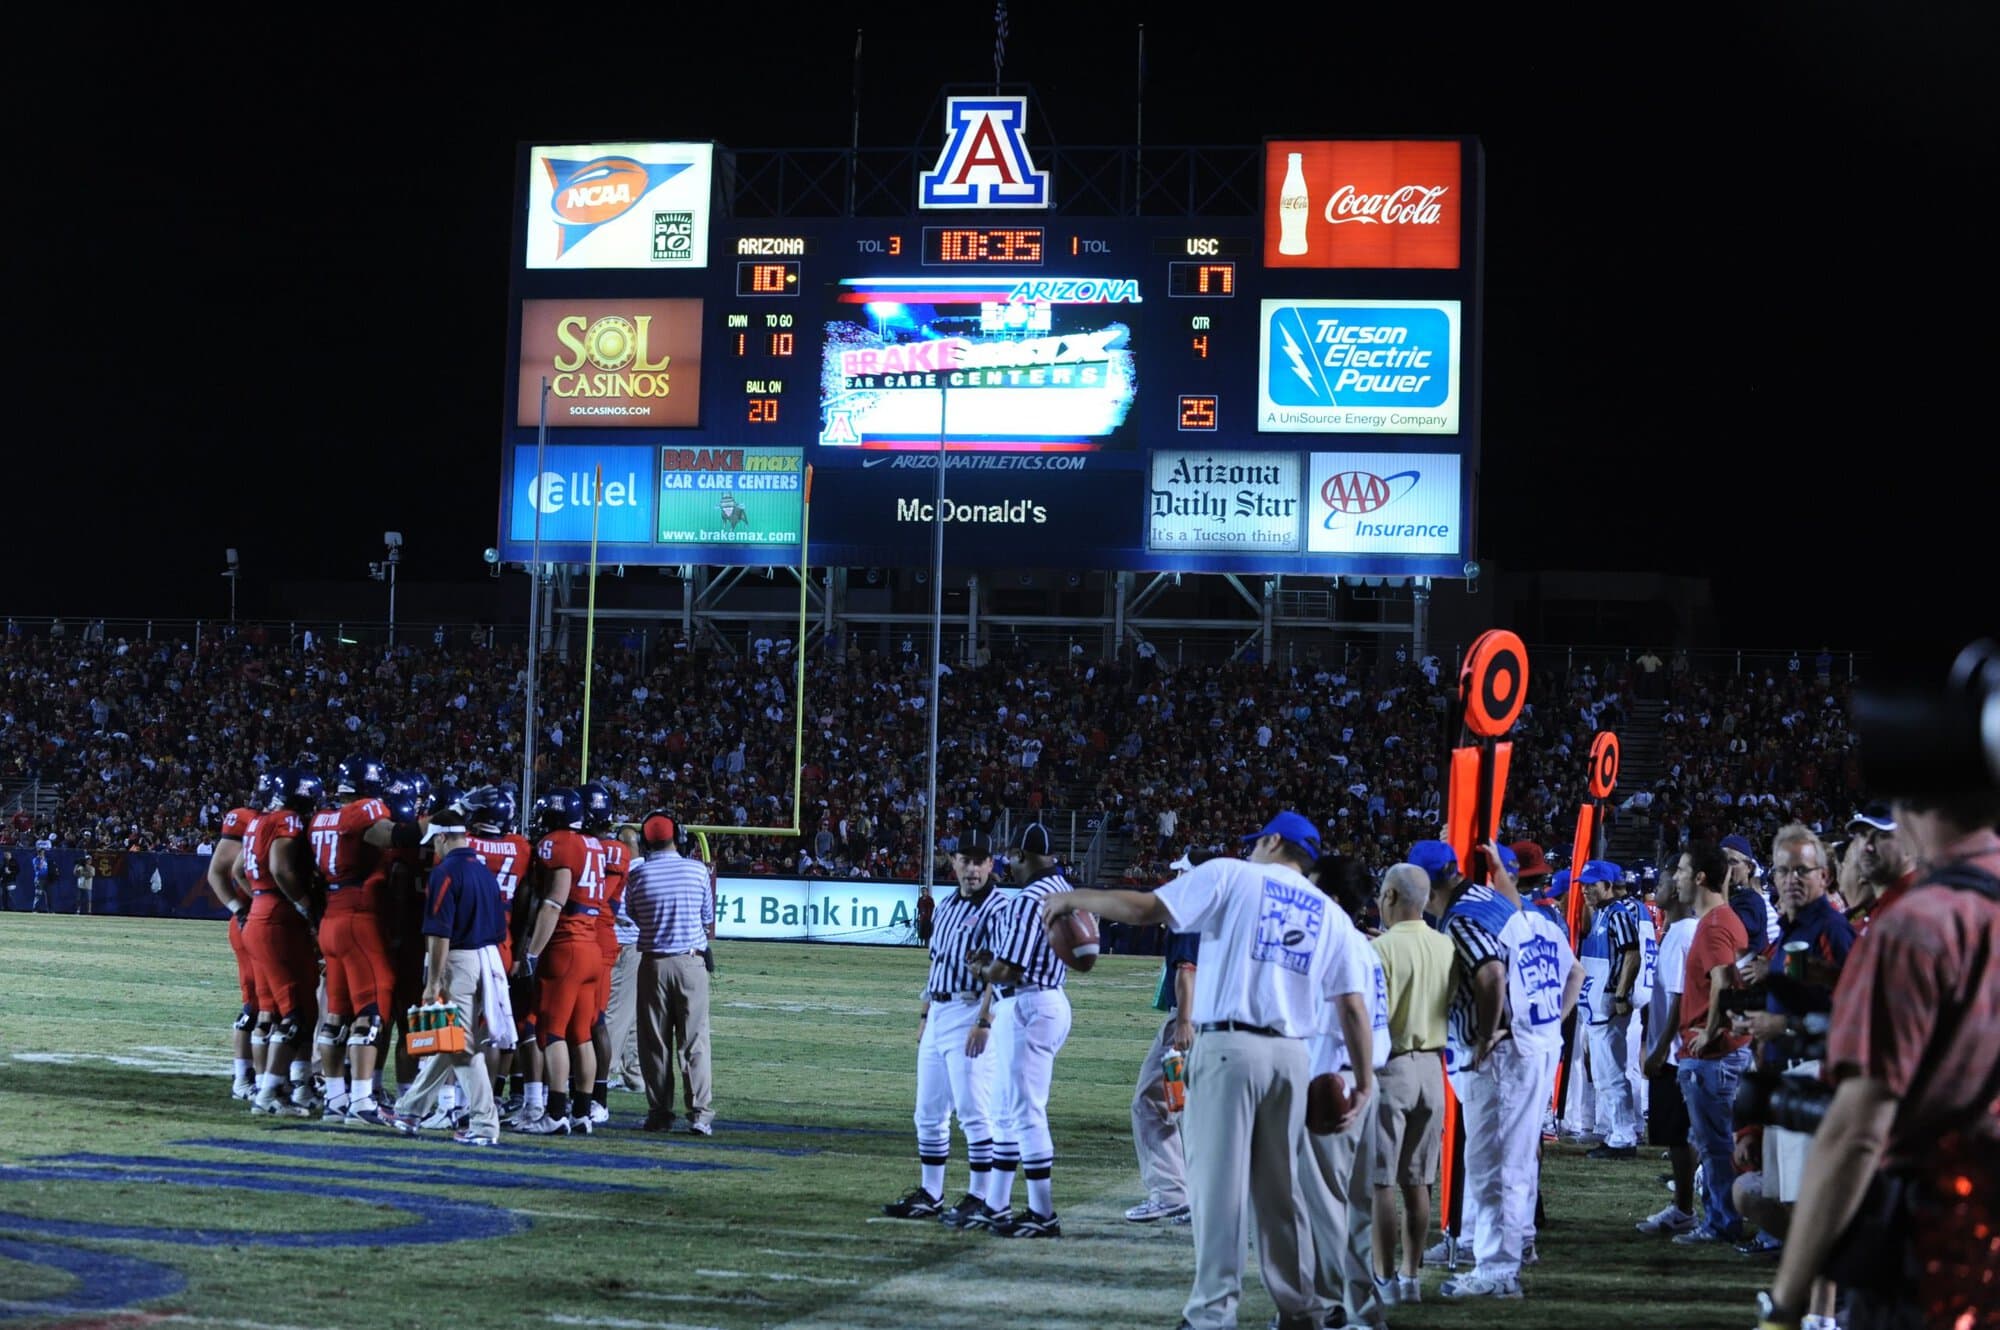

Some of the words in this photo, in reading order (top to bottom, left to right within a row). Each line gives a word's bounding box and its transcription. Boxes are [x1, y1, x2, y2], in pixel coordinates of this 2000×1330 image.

[919, 96, 1049, 208] A
[566, 183, 630, 208] NCAA
[1325, 185, 1448, 225] Coca-Cola
[655, 223, 691, 235] PAC
[655, 235, 691, 251] 10
[738, 237, 804, 255] ARIZONA
[856, 240, 885, 252] TOL
[889, 236, 900, 255] 3
[941, 231, 1041, 261] 10:35
[1082, 240, 1111, 252] TOL
[1186, 238, 1219, 255] USC
[753, 266, 785, 291] 10
[1199, 266, 1232, 292] 17
[1008, 279, 1141, 302] ARIZONA
[728, 315, 748, 327] DWN
[766, 315, 777, 327] TO
[779, 315, 792, 327] GO
[1192, 316, 1210, 330] QTR
[1315, 319, 1407, 344] Tucson
[554, 315, 670, 372] SOL
[739, 333, 744, 356] 1
[772, 333, 793, 356] 10
[1193, 336, 1207, 358] 4
[1324, 345, 1433, 369] Electric
[552, 373, 670, 398] CASINOS
[746, 381, 766, 393] BALL
[769, 381, 782, 393] ON
[845, 376, 875, 388] CAR
[884, 374, 936, 388] CARE
[950, 367, 1099, 386] CENTERS
[1335, 368, 1431, 393] Power
[570, 406, 650, 415] SOLCASINOS.COM
[749, 399, 777, 422] 20
[1182, 399, 1214, 426] 25
[1267, 413, 1276, 424] A
[1280, 413, 1341, 424] UniSource
[1345, 413, 1387, 426] Energy
[1390, 413, 1448, 426] Company
[891, 455, 1086, 470] ARIZONAATHLETICS.COM
[1168, 456, 1280, 485] Arizona
[665, 474, 692, 489] CAR
[697, 474, 733, 489] CARE
[738, 475, 798, 490] CENTERS
[1325, 472, 1386, 513] AAA
[897, 498, 1047, 523] McDonald's
[1151, 489, 1227, 523] Daily
[1234, 490, 1297, 517] Star
[663, 529, 796, 542] www.brakemax.com
[1152, 528, 1174, 541] It's
[1179, 531, 1187, 541] a
[1193, 528, 1246, 542] Tucson
[1356, 520, 1449, 537] Insurance
[361, 799, 383, 820] 77
[310, 830, 339, 876] 77
[606, 846, 622, 865] 11
[716, 894, 746, 924] #1
[760, 896, 841, 926] Bank
[851, 898, 879, 927] in
[889, 900, 918, 929] A
